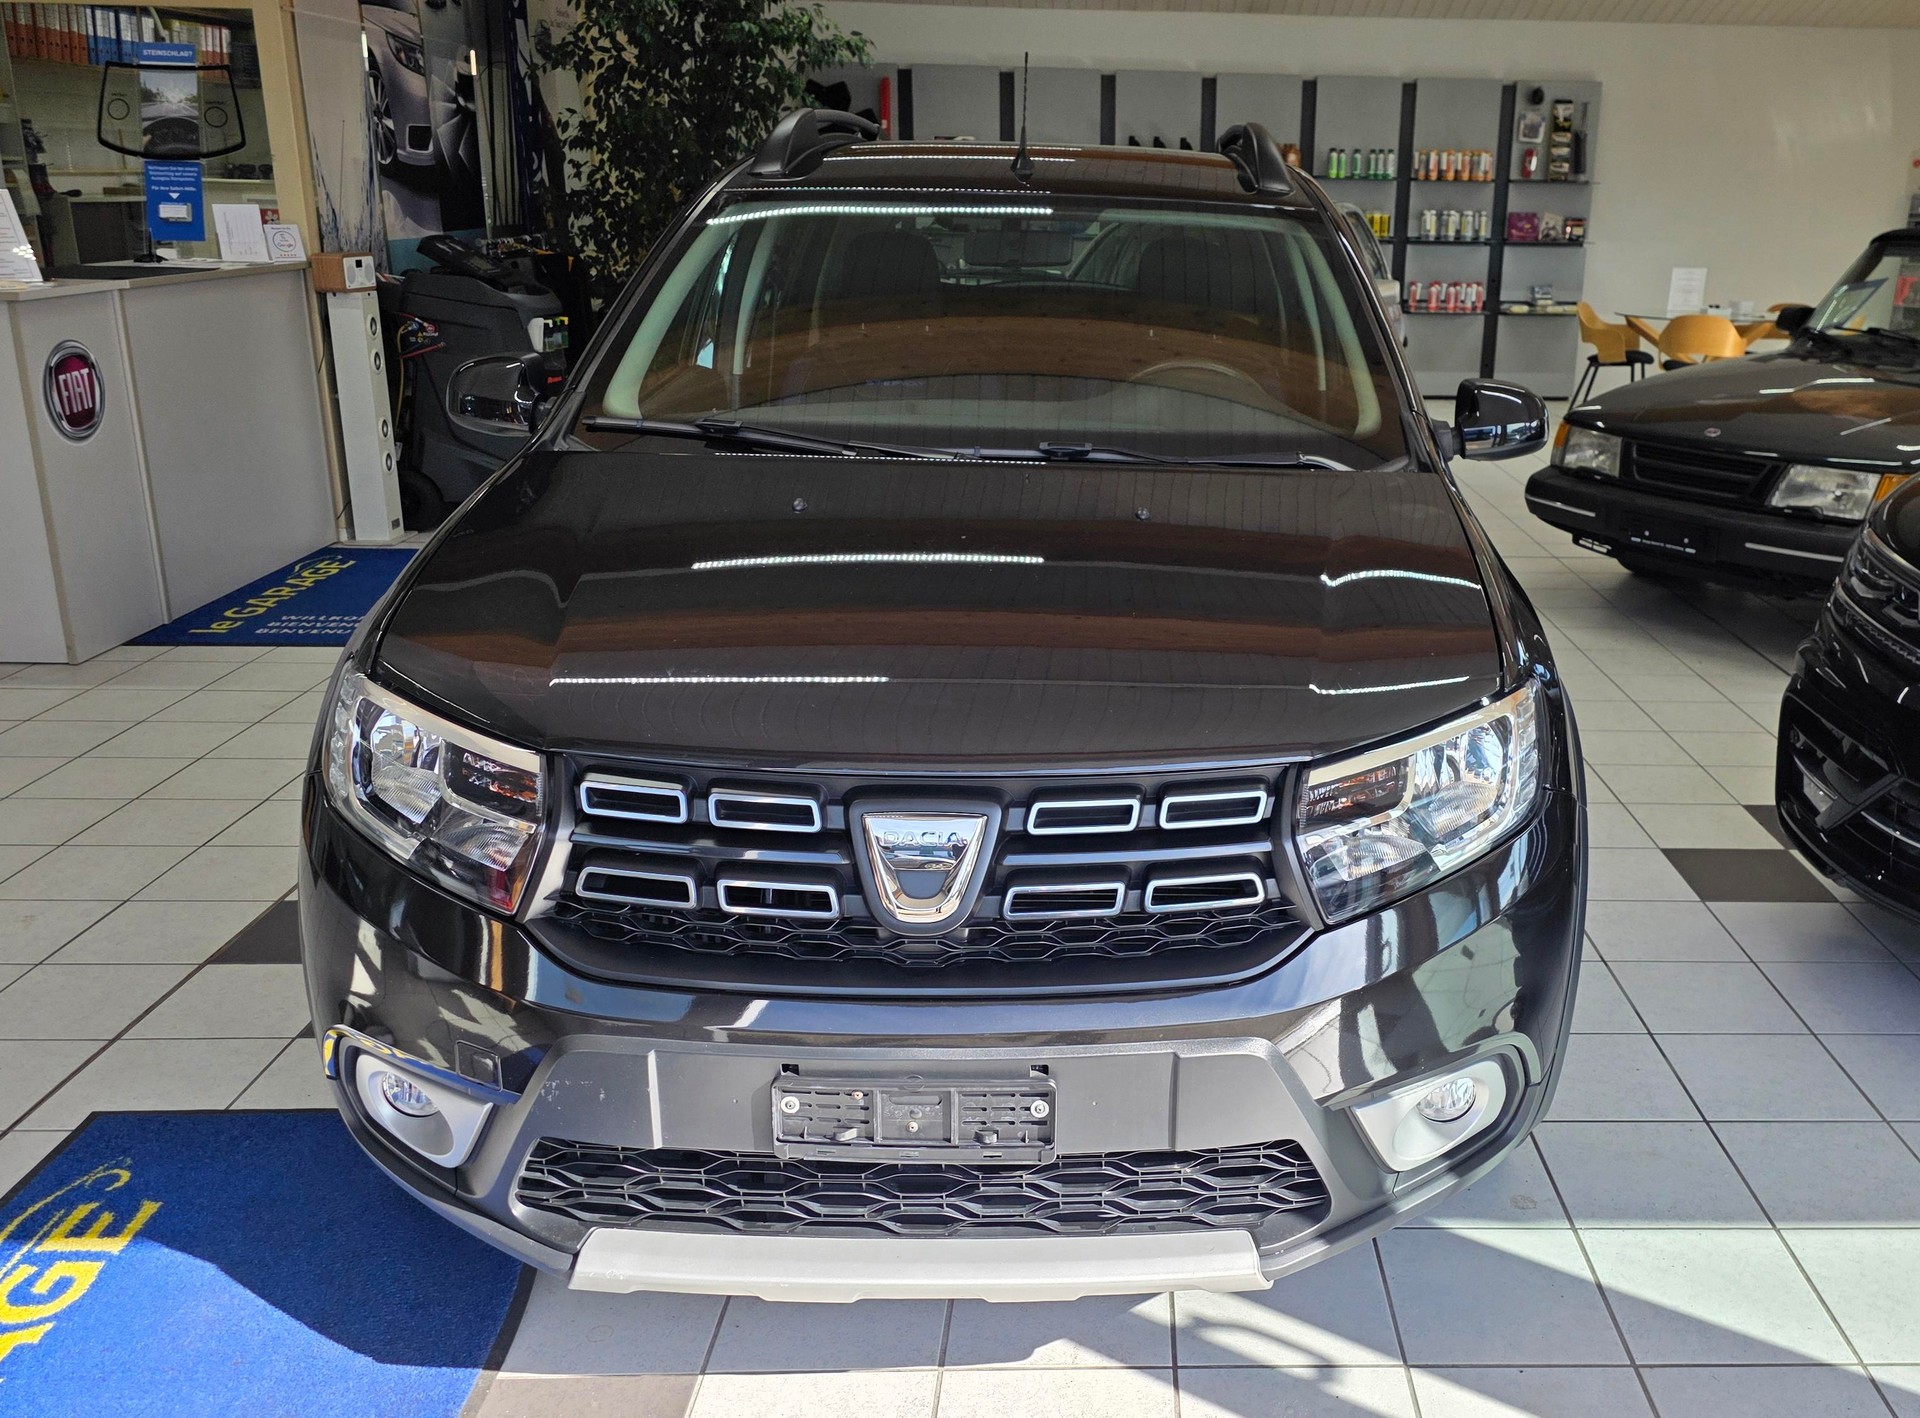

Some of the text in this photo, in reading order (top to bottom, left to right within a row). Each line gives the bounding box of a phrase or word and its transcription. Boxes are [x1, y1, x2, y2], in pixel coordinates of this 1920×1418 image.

[143, 49, 193, 58] STEINSCHLAG?
[58, 367, 93, 416] FIAT
[188, 560, 357, 635] le GARAGE
[883, 831, 963, 847] DACIA
